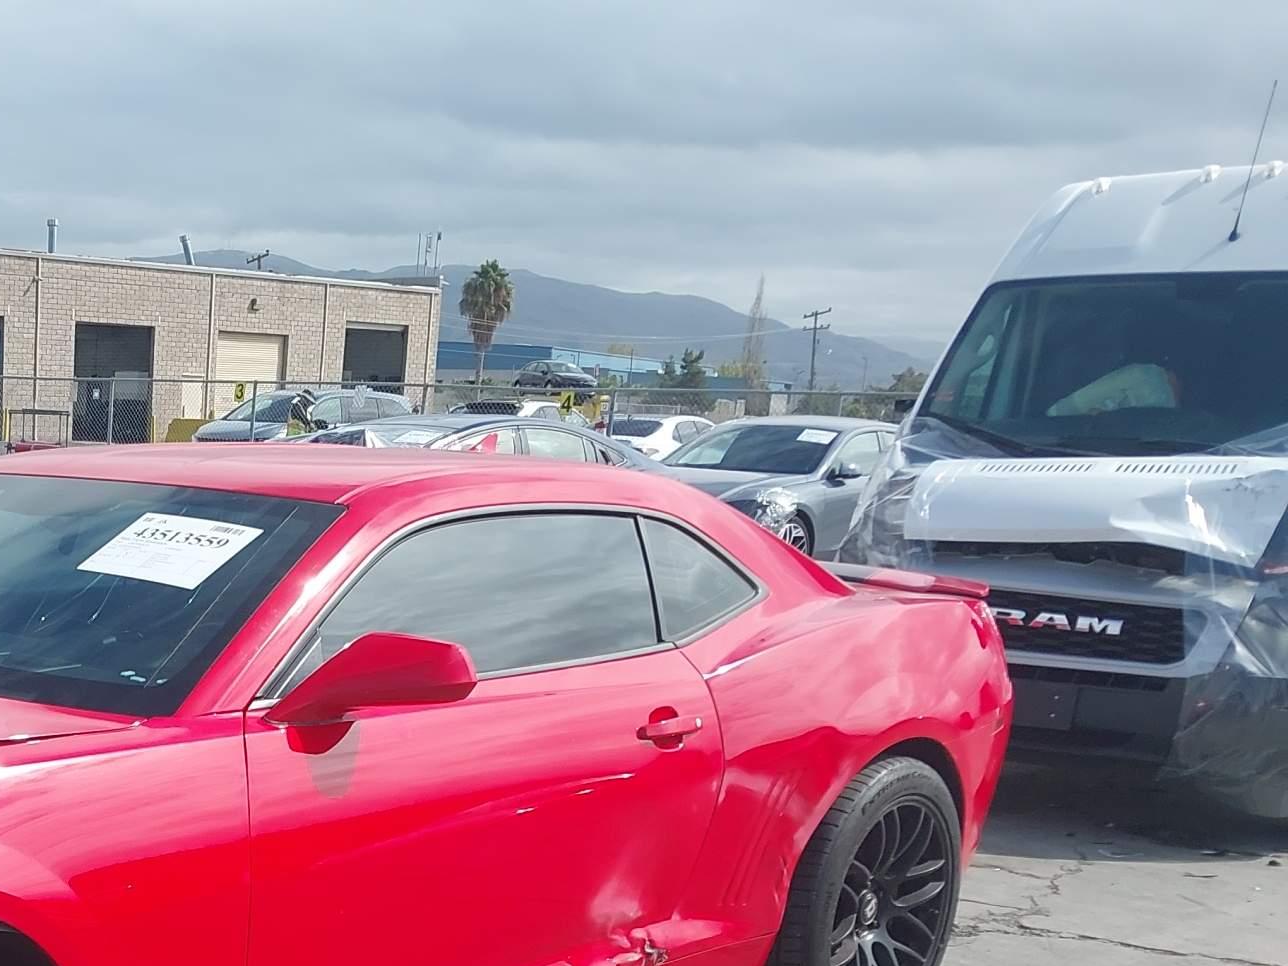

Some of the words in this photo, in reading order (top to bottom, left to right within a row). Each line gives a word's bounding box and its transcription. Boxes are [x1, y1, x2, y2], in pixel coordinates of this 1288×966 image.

[235, 383, 245, 400] 3
[561, 394, 572, 412] 4
[132, 526, 231, 550] 43513559
[990, 606, 1125, 636] RAM
